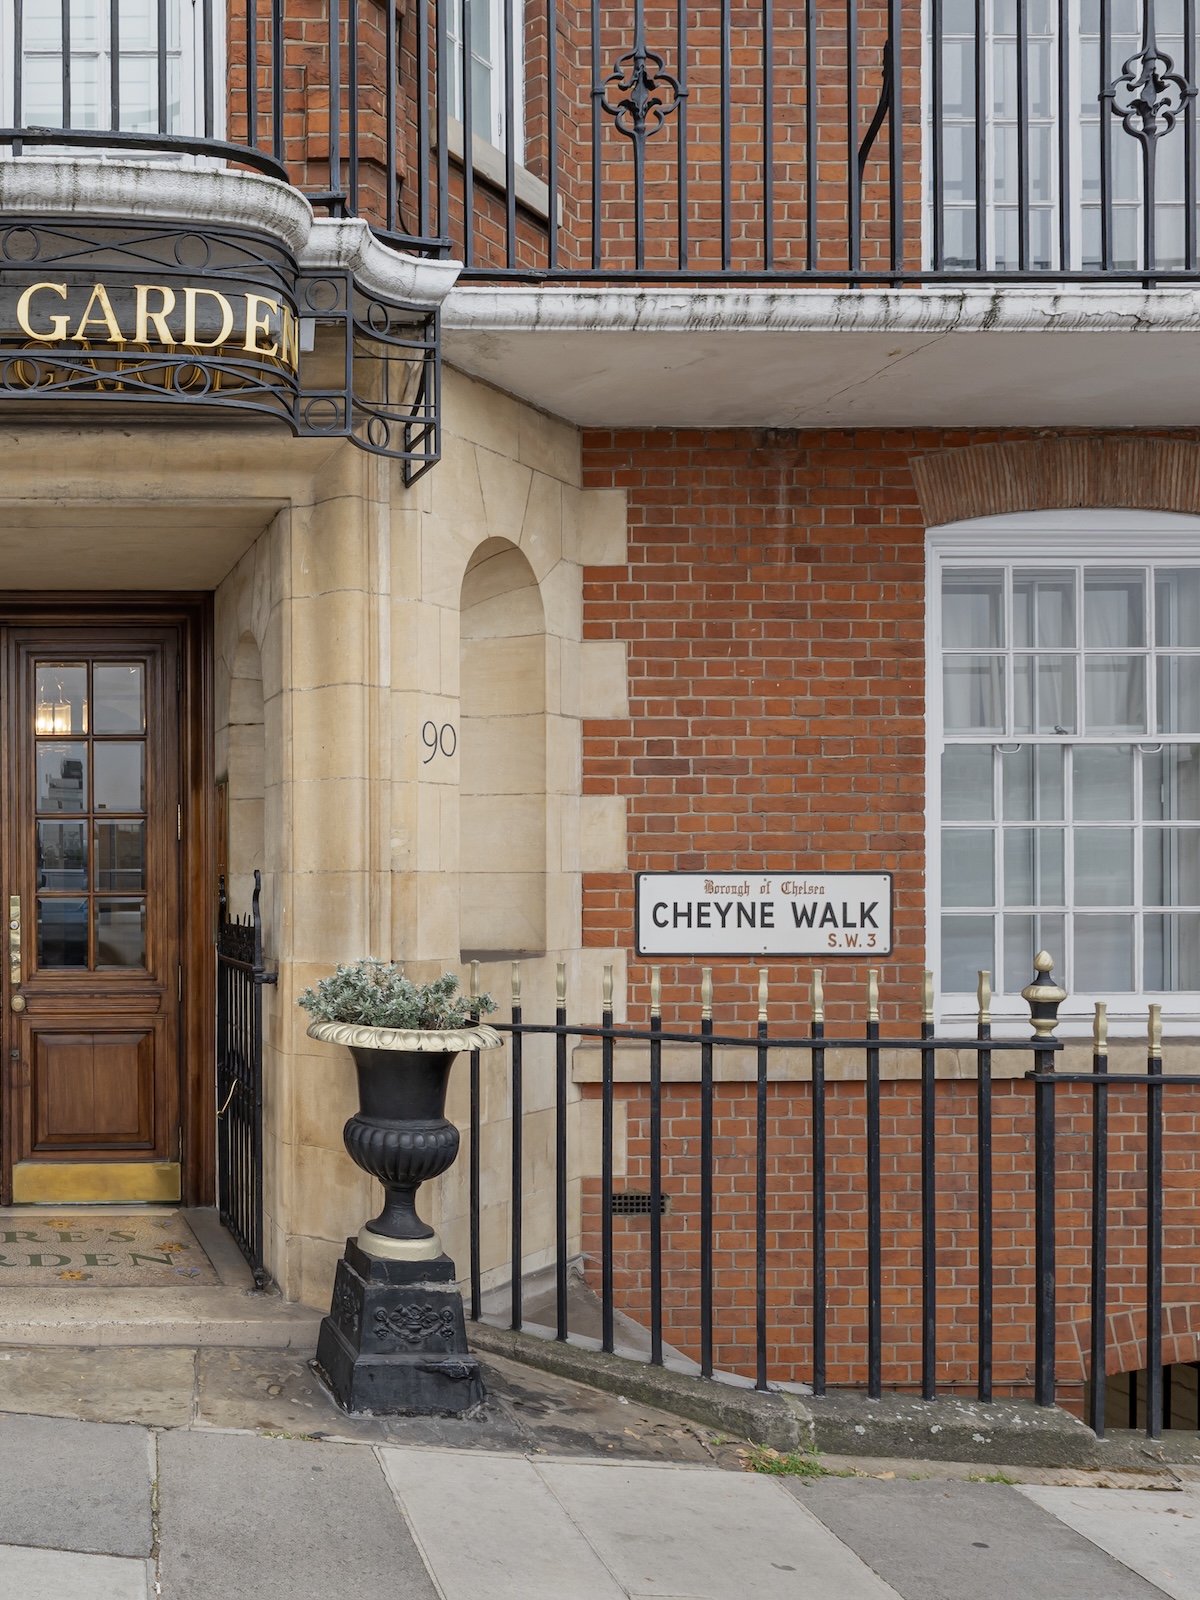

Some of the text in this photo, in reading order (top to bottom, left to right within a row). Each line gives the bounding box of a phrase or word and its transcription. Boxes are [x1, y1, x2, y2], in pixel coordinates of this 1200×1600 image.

[16, 282, 299, 374] GARDEN
[422, 720, 457, 764] 90
[704, 879, 826, 897] Borough of Chelsea
[652, 901, 879, 929] CHEYNE WALK
